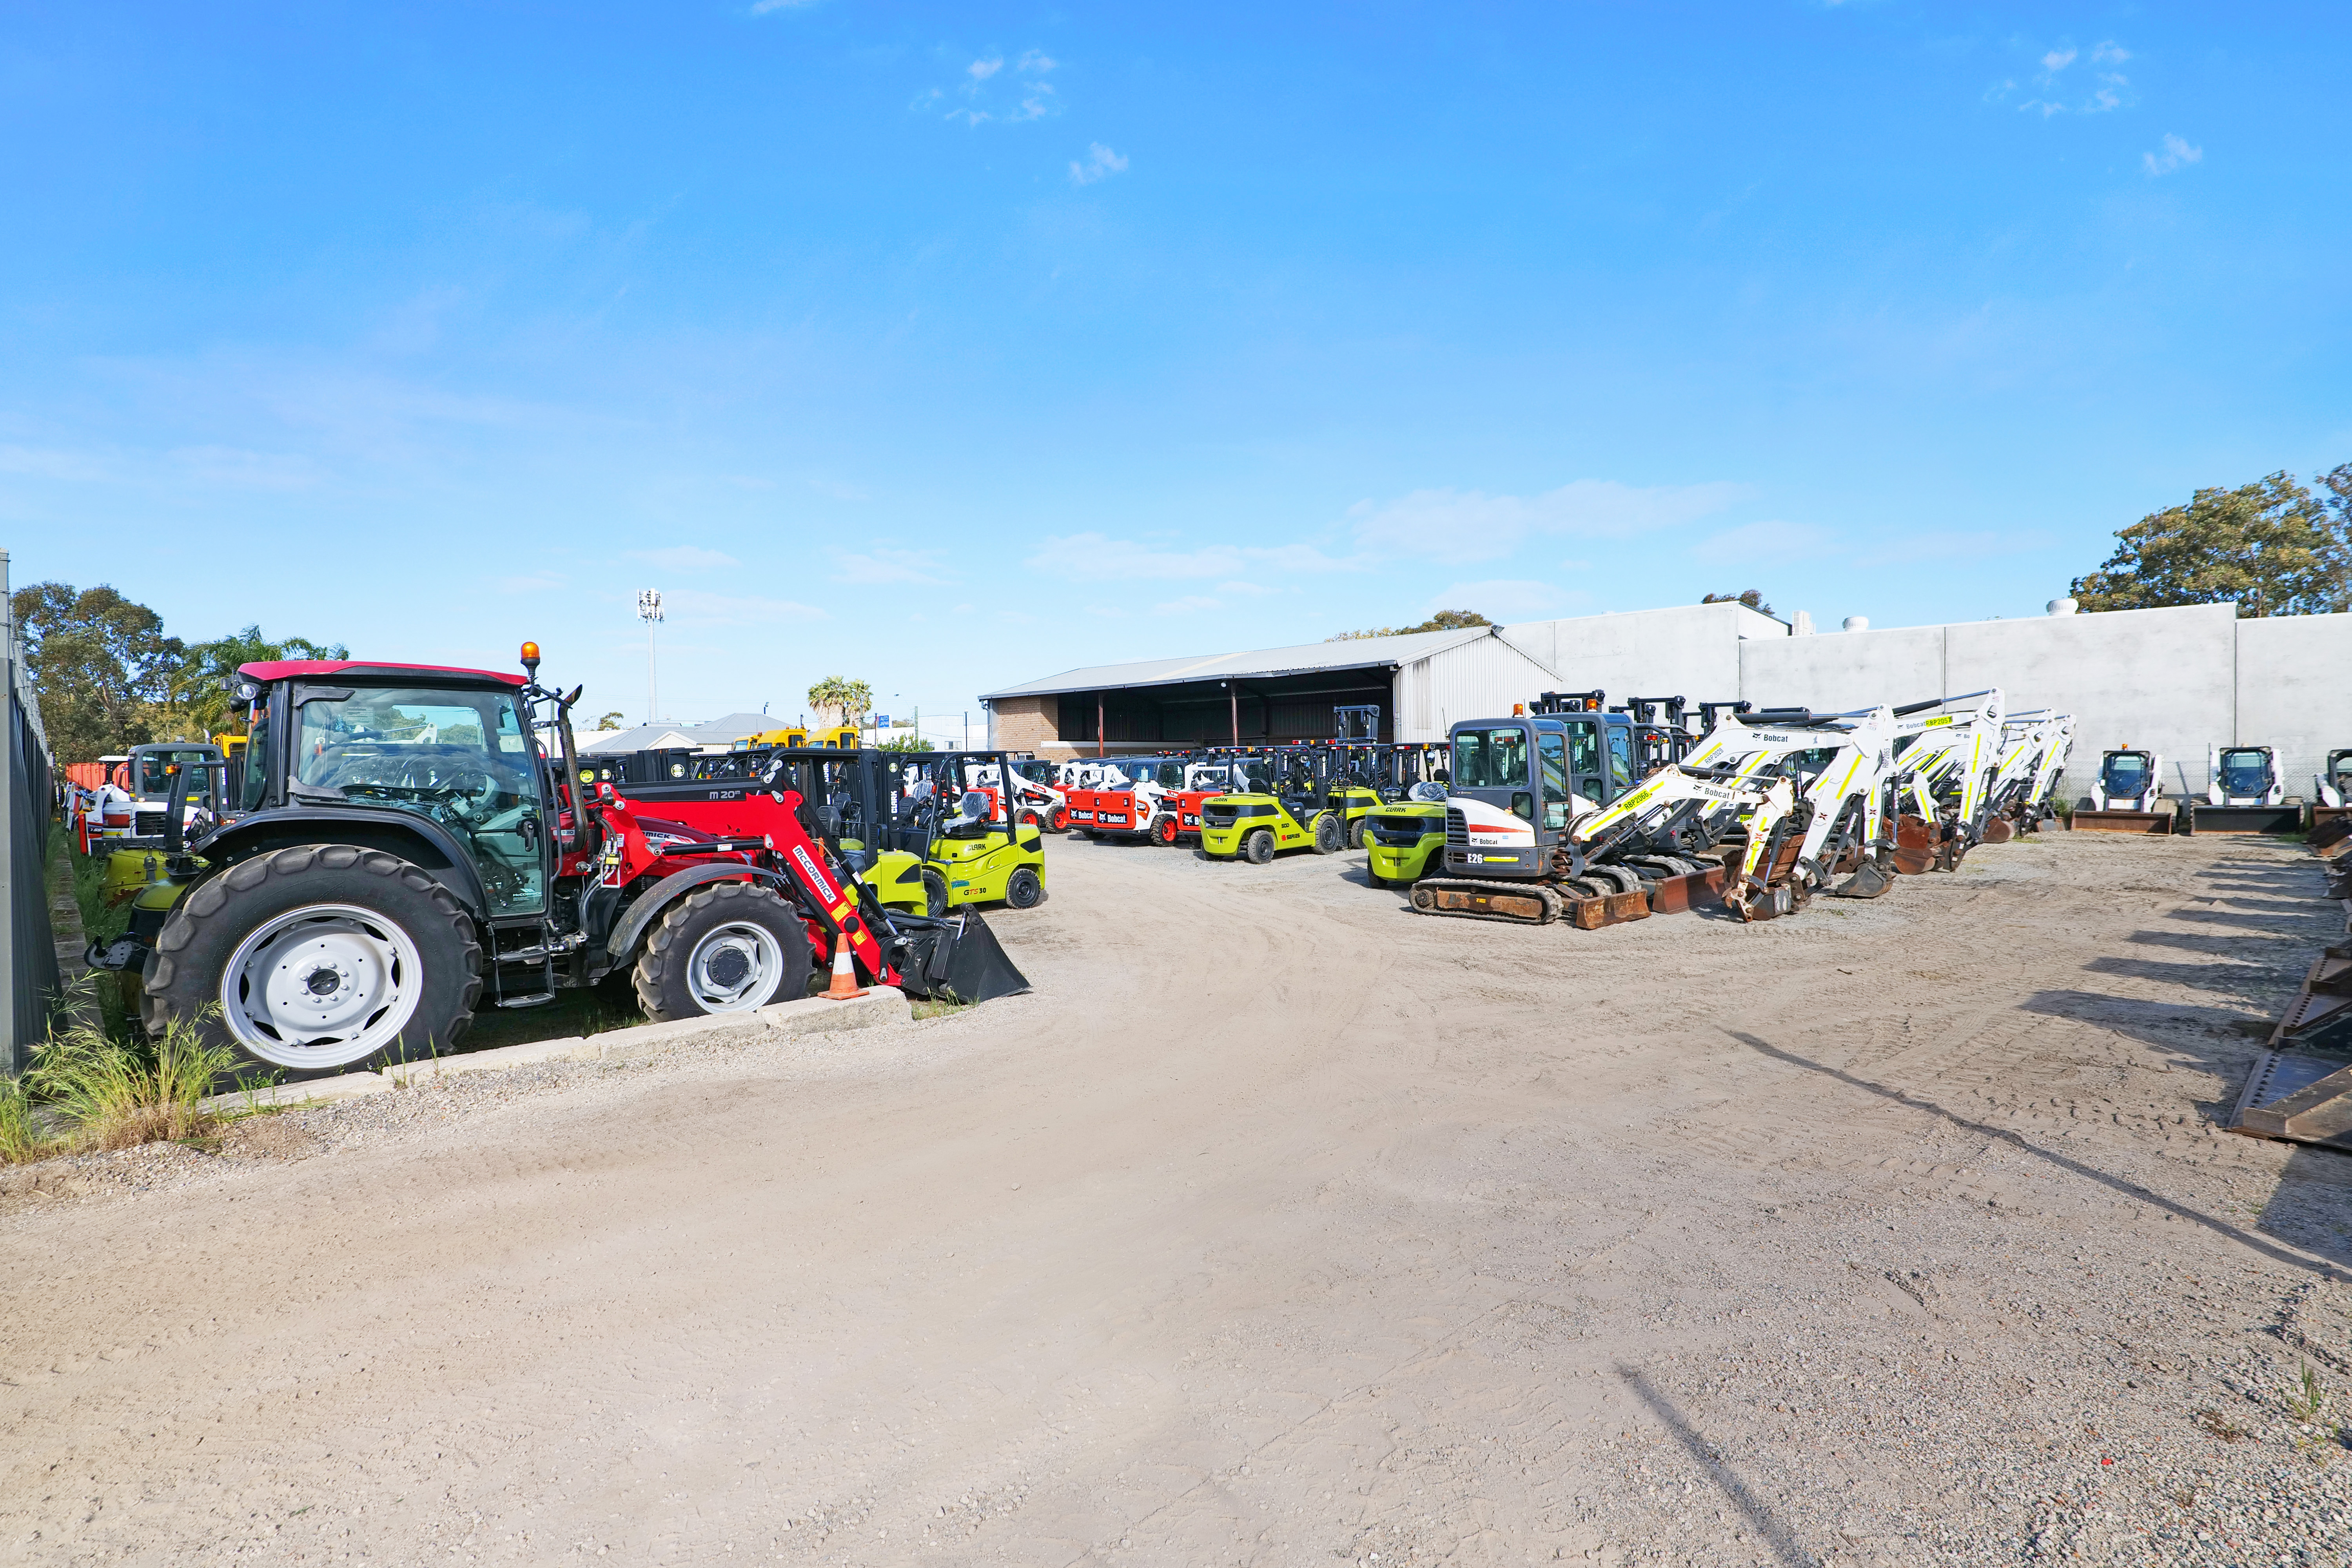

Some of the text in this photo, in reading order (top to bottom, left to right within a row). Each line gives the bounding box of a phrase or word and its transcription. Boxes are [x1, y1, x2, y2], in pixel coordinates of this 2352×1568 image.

[1926, 717, 1951, 726] RBP2057
[1704, 748, 1724, 764] RBP2028
[1882, 748, 1890, 768] RBP2065
[1704, 788, 1730, 799] Bobcat
[1624, 791, 1649, 810] RBP2066
[1107, 815, 1126, 823] Bobcat
[1467, 853, 1483, 864] E26
